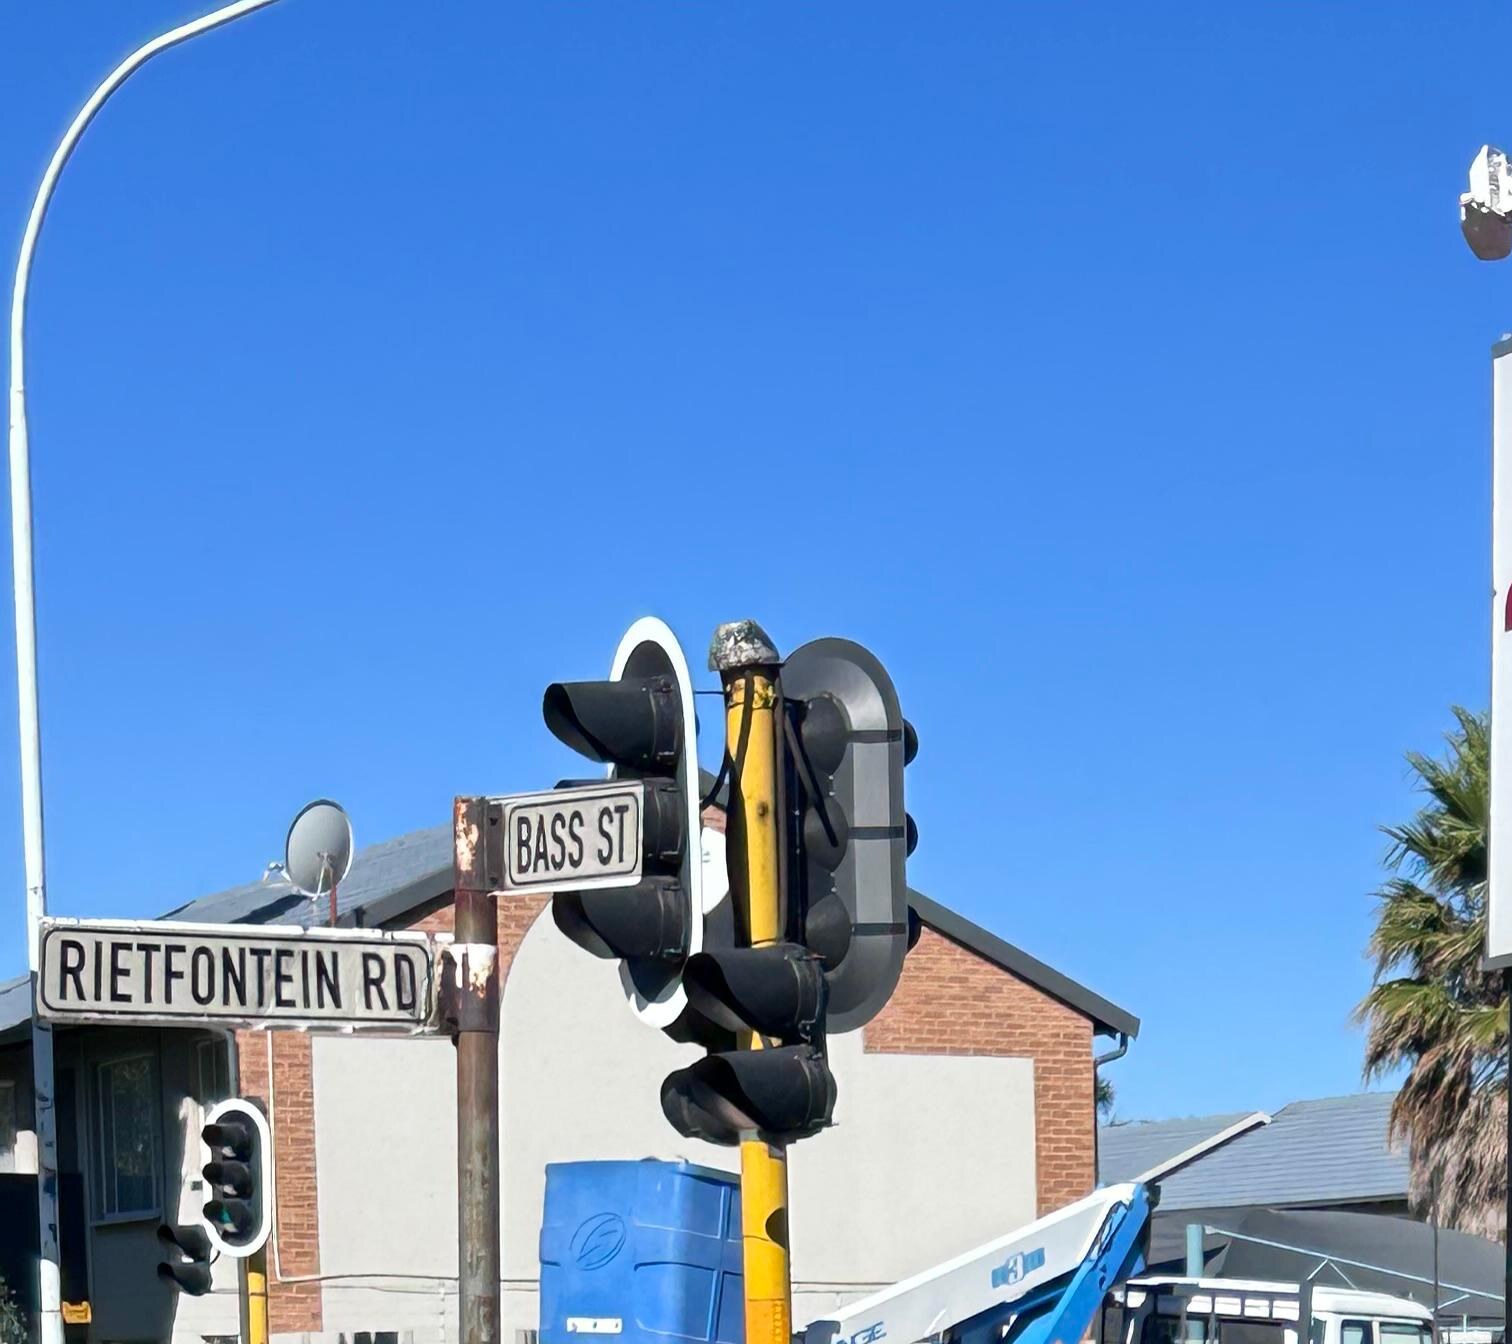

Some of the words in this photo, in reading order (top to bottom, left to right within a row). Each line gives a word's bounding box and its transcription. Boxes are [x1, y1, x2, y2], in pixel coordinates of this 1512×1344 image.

[517, 810, 585, 874] BASS
[597, 804, 629, 866] ST
[58, 939, 343, 1010] RIETFONTEIN
[362, 951, 418, 1011] RD
